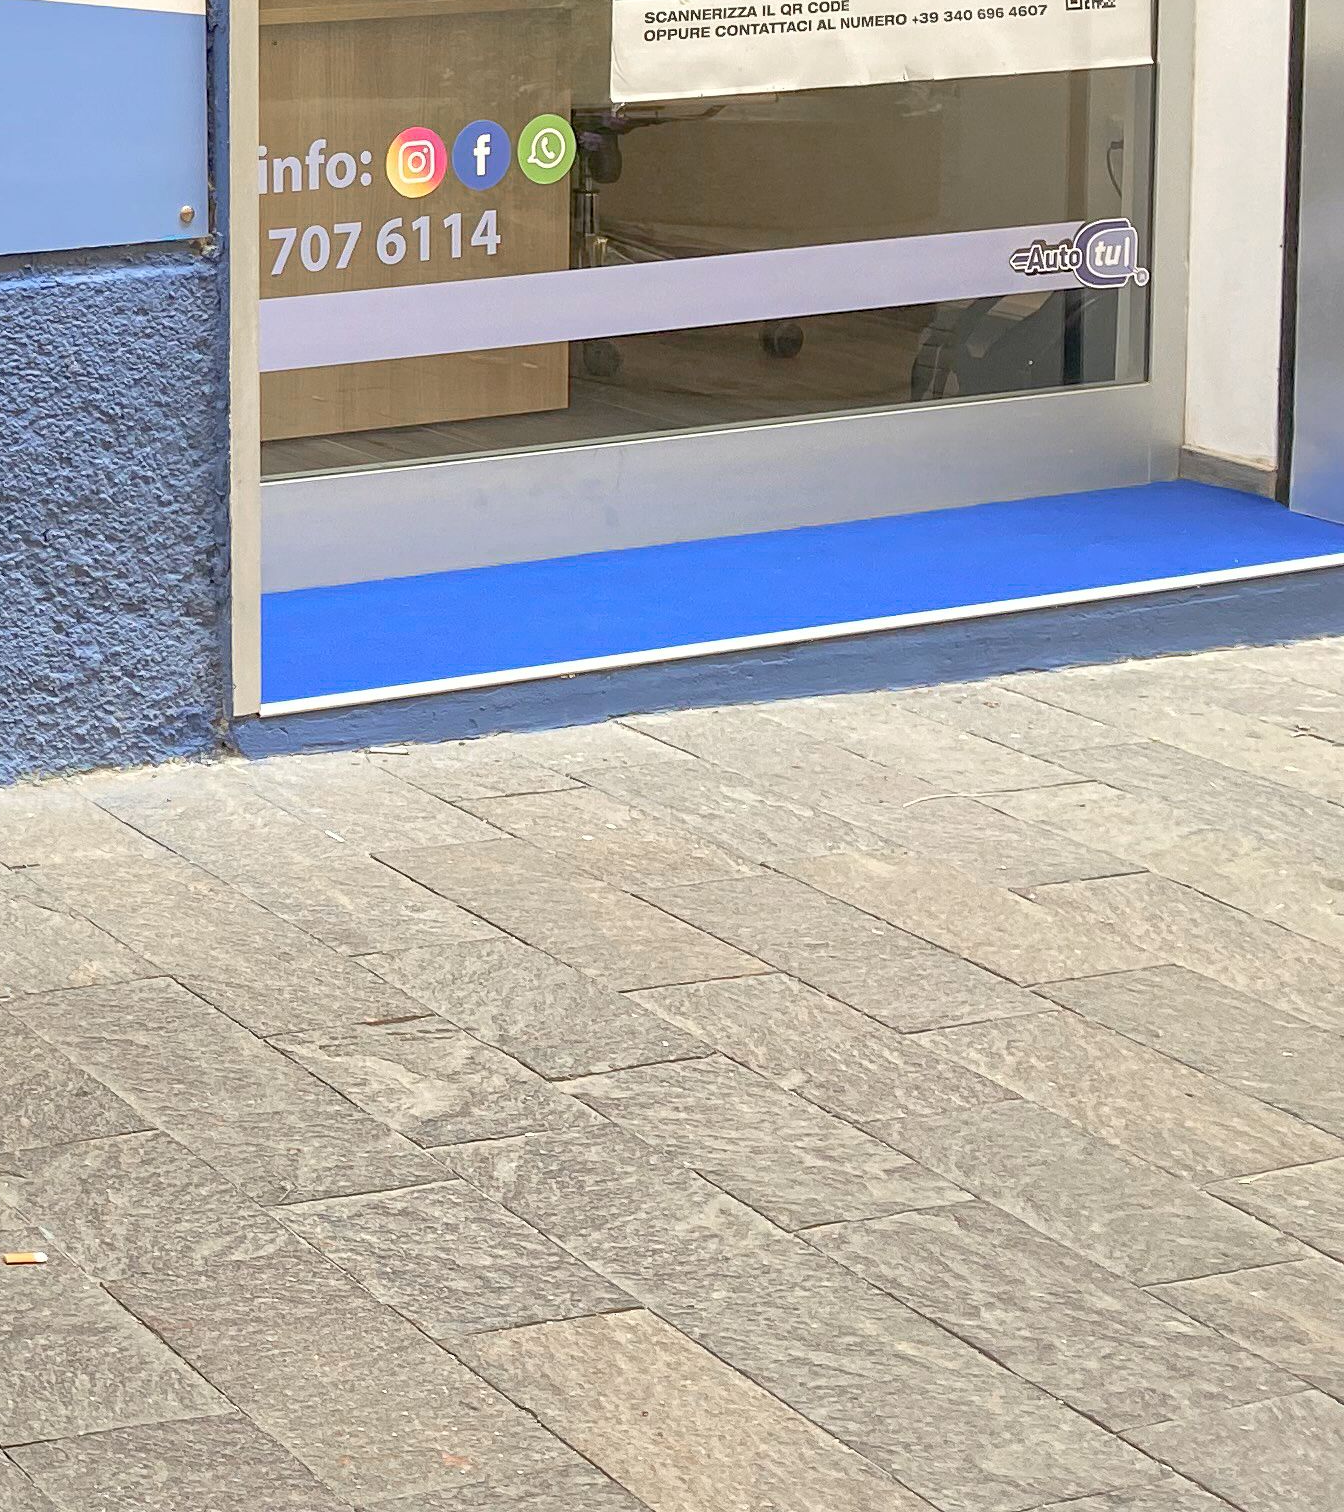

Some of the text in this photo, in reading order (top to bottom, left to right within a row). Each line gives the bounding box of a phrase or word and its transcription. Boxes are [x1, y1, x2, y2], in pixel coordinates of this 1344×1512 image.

[644, 0, 850, 24] SCANNERIZZA IL QR CODE
[644, 5, 1048, 42] OPPURE CONTATTACI AL NUMERO +39 340 696 4607
[258, 139, 372, 195] info:
[268, 210, 501, 276] 707 6114
[1027, 241, 1121, 270] Auto tu
